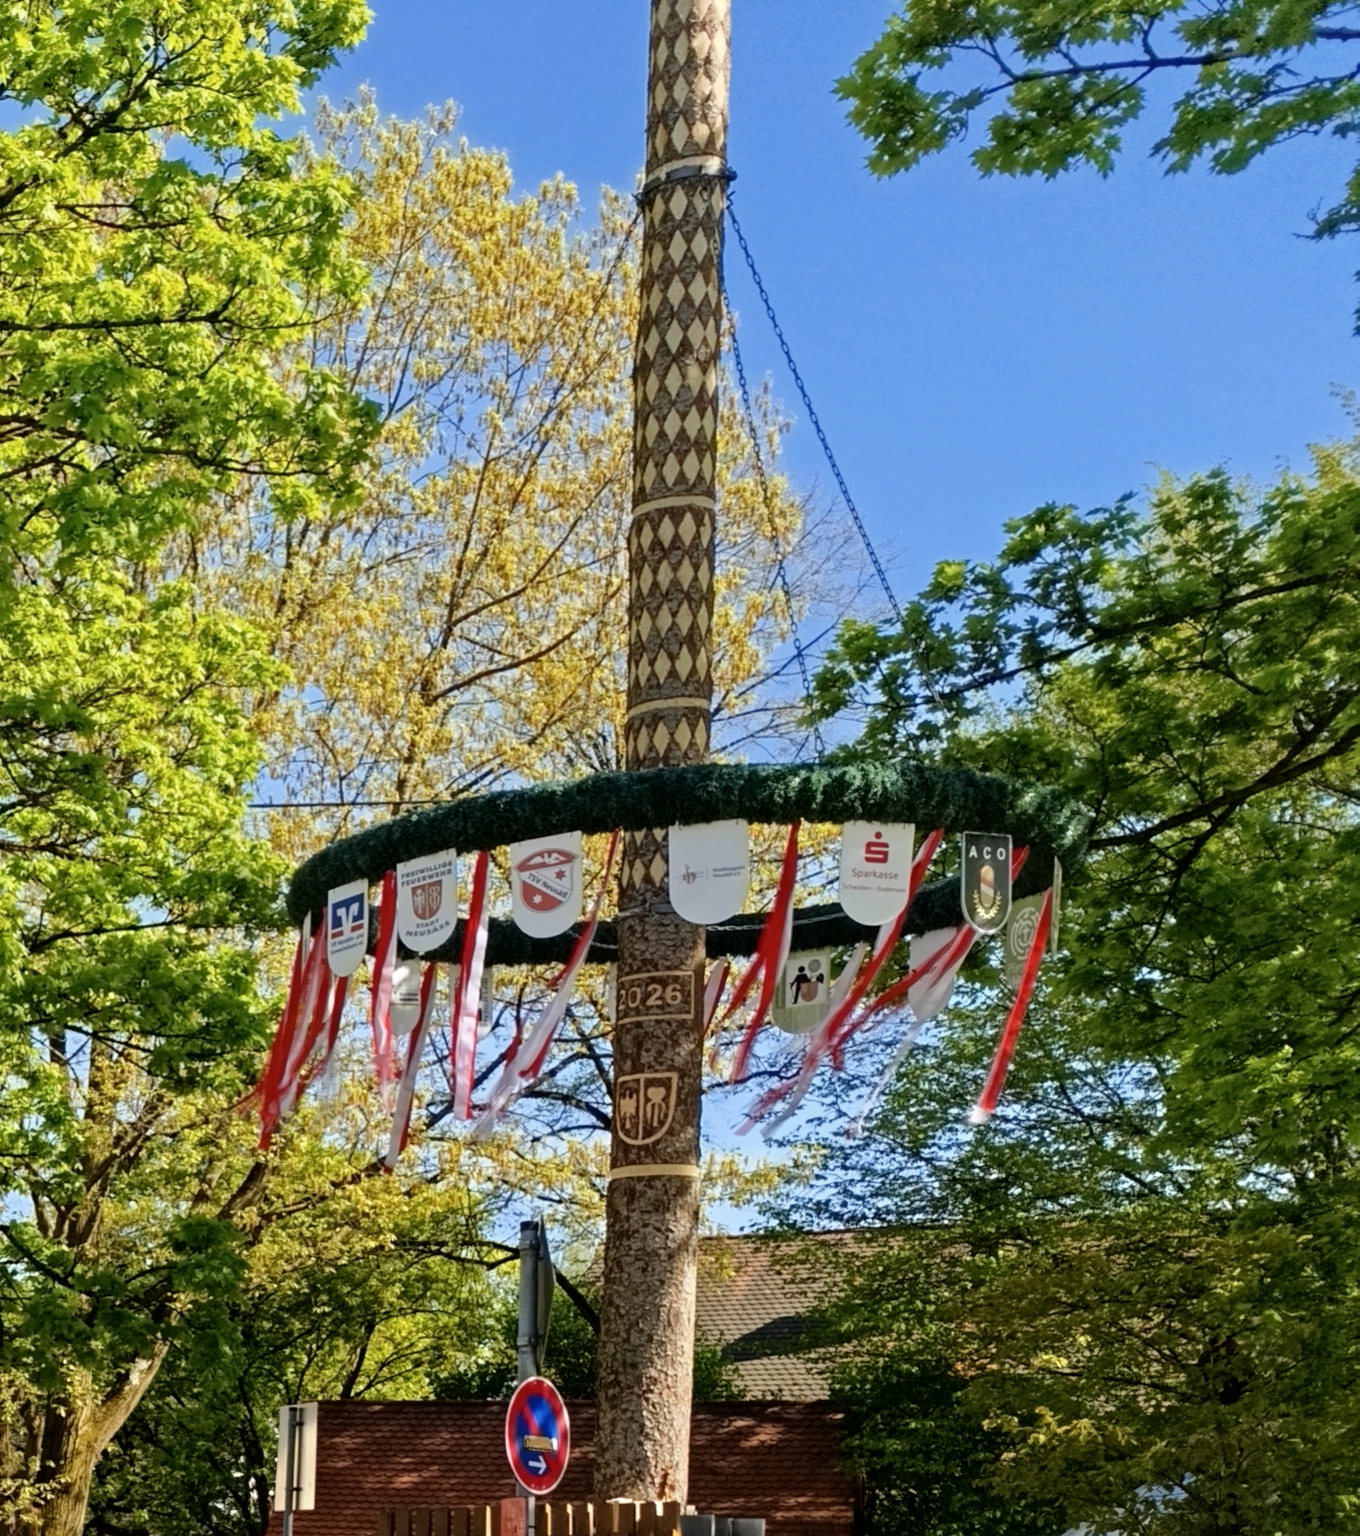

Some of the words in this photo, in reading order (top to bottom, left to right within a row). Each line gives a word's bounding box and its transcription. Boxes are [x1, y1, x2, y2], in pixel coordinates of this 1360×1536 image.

[968, 845, 1006, 860] ACO
[401, 861, 453, 879] FREIWILLIGE
[401, 868, 453, 887] FEUERWEHR
[852, 868, 899, 880] Sparkasse
[527, 872, 542, 884] TSV
[541, 880, 569, 899] Neusäß
[416, 918, 440, 928] STADT
[618, 983, 682, 1011] 2026
